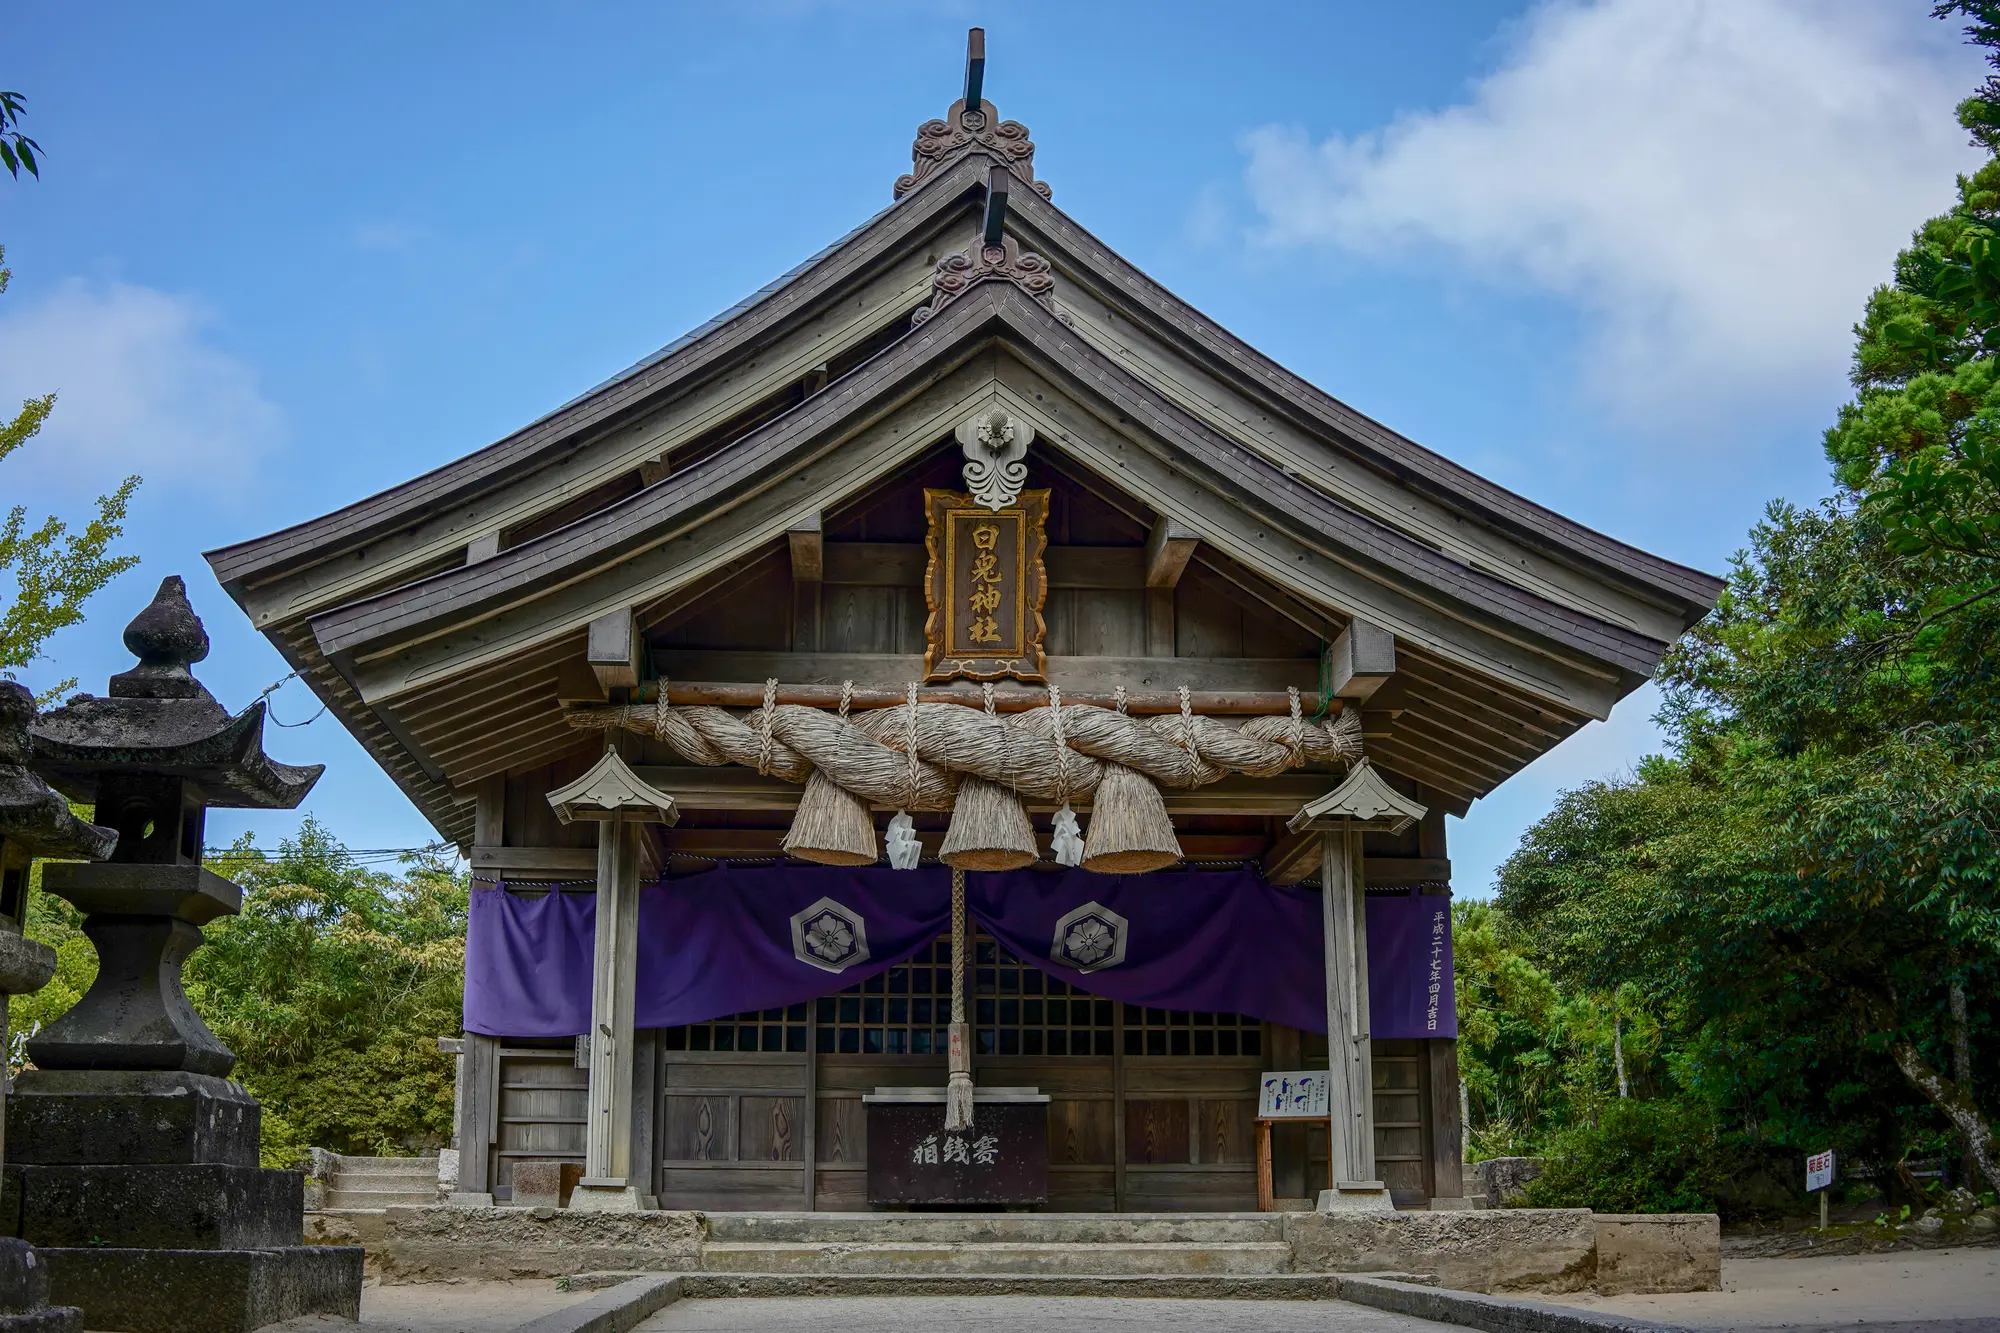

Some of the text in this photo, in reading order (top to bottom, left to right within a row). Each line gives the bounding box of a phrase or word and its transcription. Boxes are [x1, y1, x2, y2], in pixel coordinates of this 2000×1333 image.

[1427, 911, 1445, 1031] 平成二十七年四月吉日
